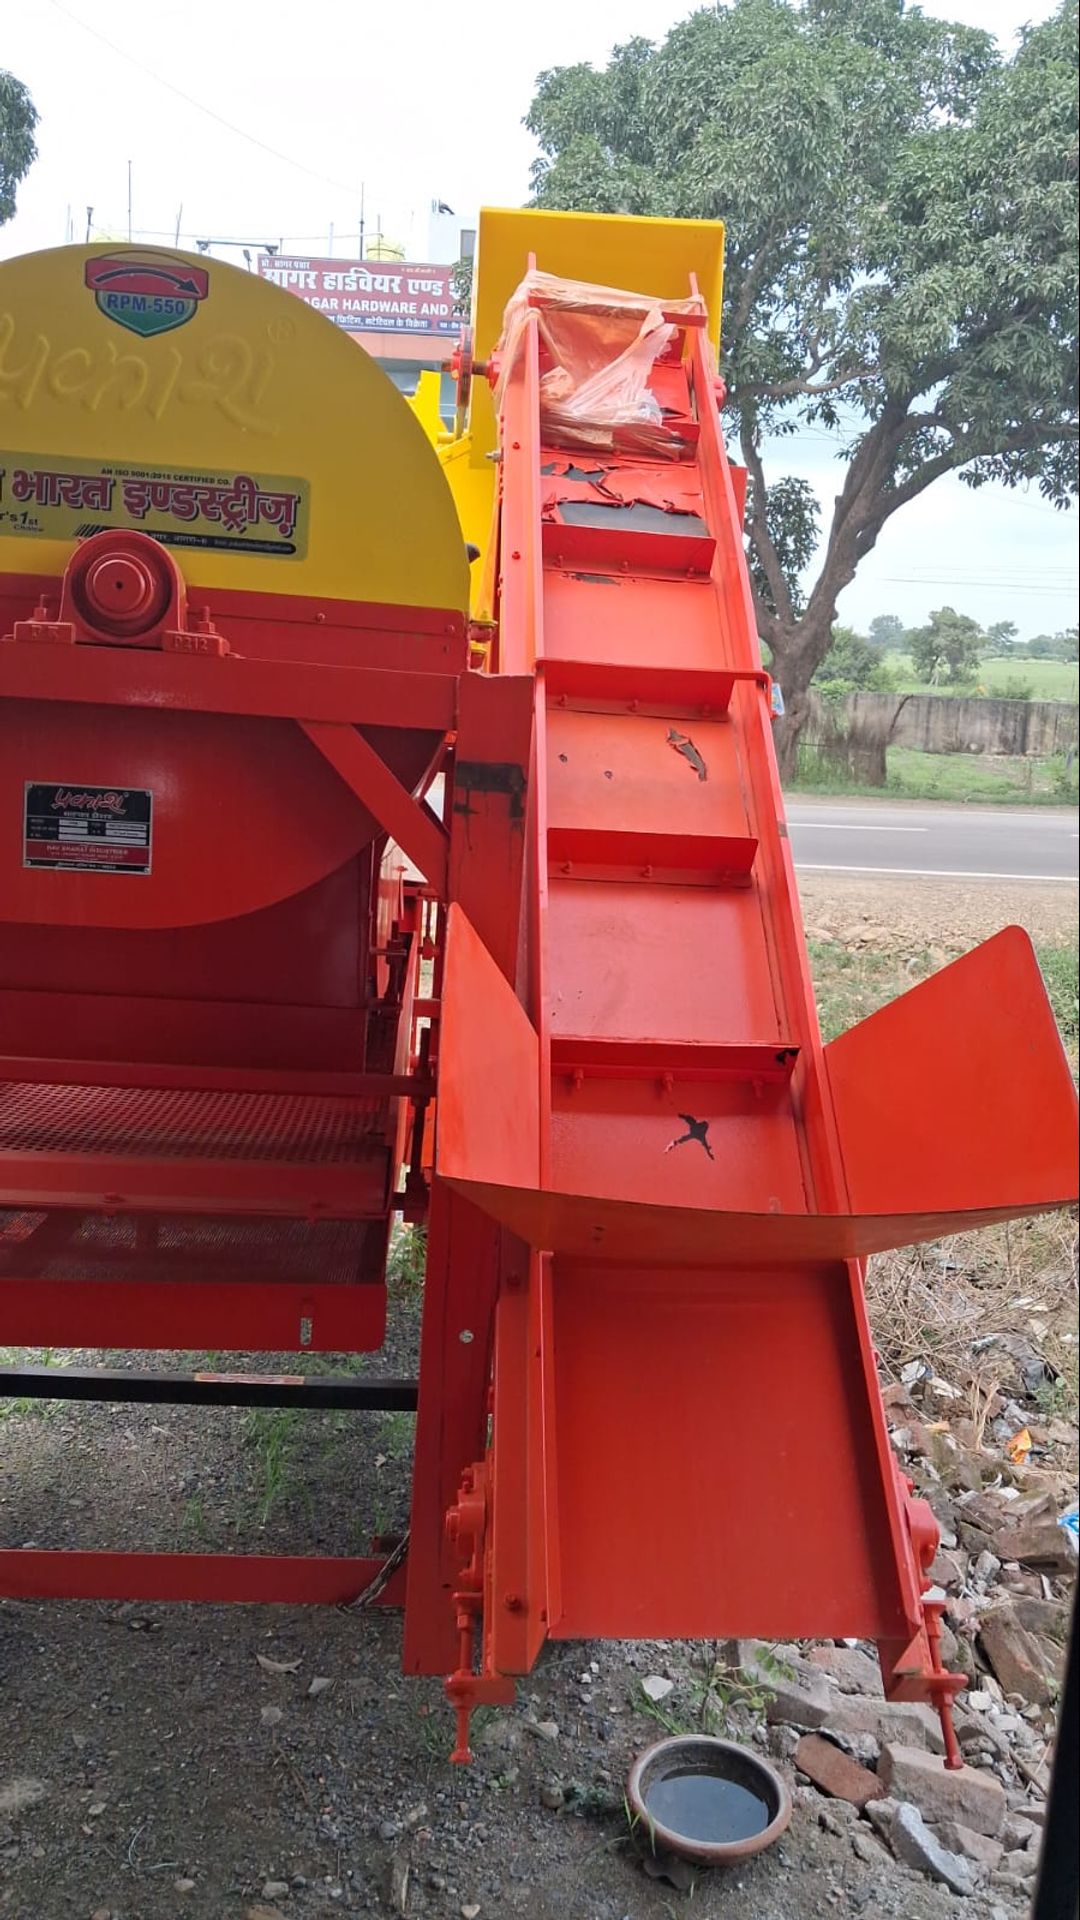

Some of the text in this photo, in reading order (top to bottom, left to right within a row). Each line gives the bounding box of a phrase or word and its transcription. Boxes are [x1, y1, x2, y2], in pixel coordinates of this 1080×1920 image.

[407, 278, 444, 297] एण्ड
[106, 294, 186, 316] RPM-550
[342, 299, 417, 314] HARDWARE
[421, 304, 448, 316] AND
[173, 475, 215, 484] CERTIFIED
[12, 469, 115, 511] भारत
